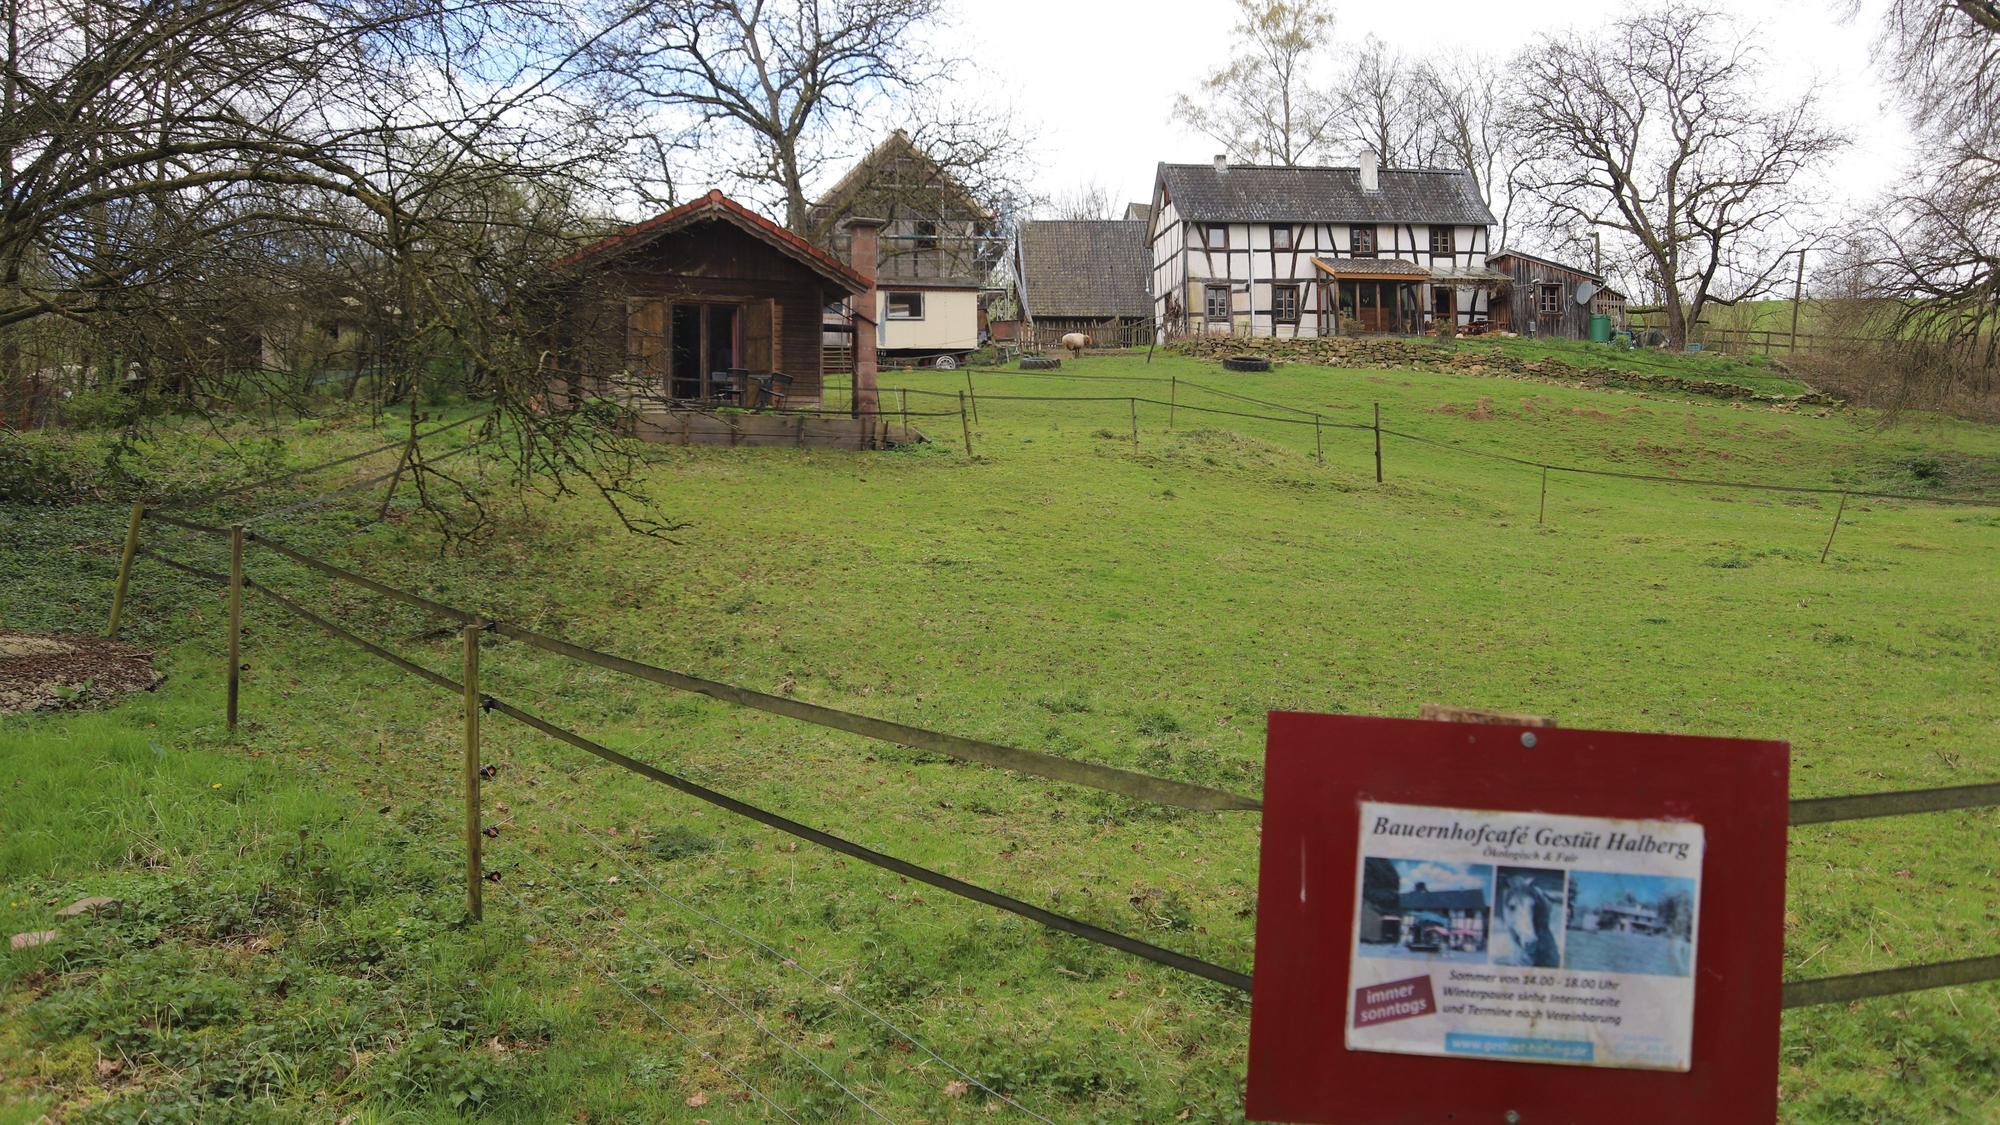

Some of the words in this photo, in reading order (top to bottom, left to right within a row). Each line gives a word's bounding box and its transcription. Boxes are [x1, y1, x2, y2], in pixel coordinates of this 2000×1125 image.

[1373, 816, 1529, 847] Bauernhofcafé
[1535, 828, 1600, 850] Gestüt
[1605, 832, 1690, 860] Halberg
[1543, 852, 1552, 862] &
[1450, 970, 1497, 982] Sommer
[1500, 976, 1521, 985] von
[1523, 975, 1555, 987] 14.00
[1564, 977, 1596, 990] 18.00
[1598, 979, 1620, 991] Uhr
[1366, 984, 1415, 1005] immer
[1442, 986, 1515, 1002] Winterpause
[1550, 993, 1621, 1008] Internetseite
[1360, 998, 1428, 1023] sonntags
[1442, 1003, 1464, 1014] und
[1467, 1004, 1512, 1017] Termine
[1546, 1008, 1622, 1027] Vereinbarung
